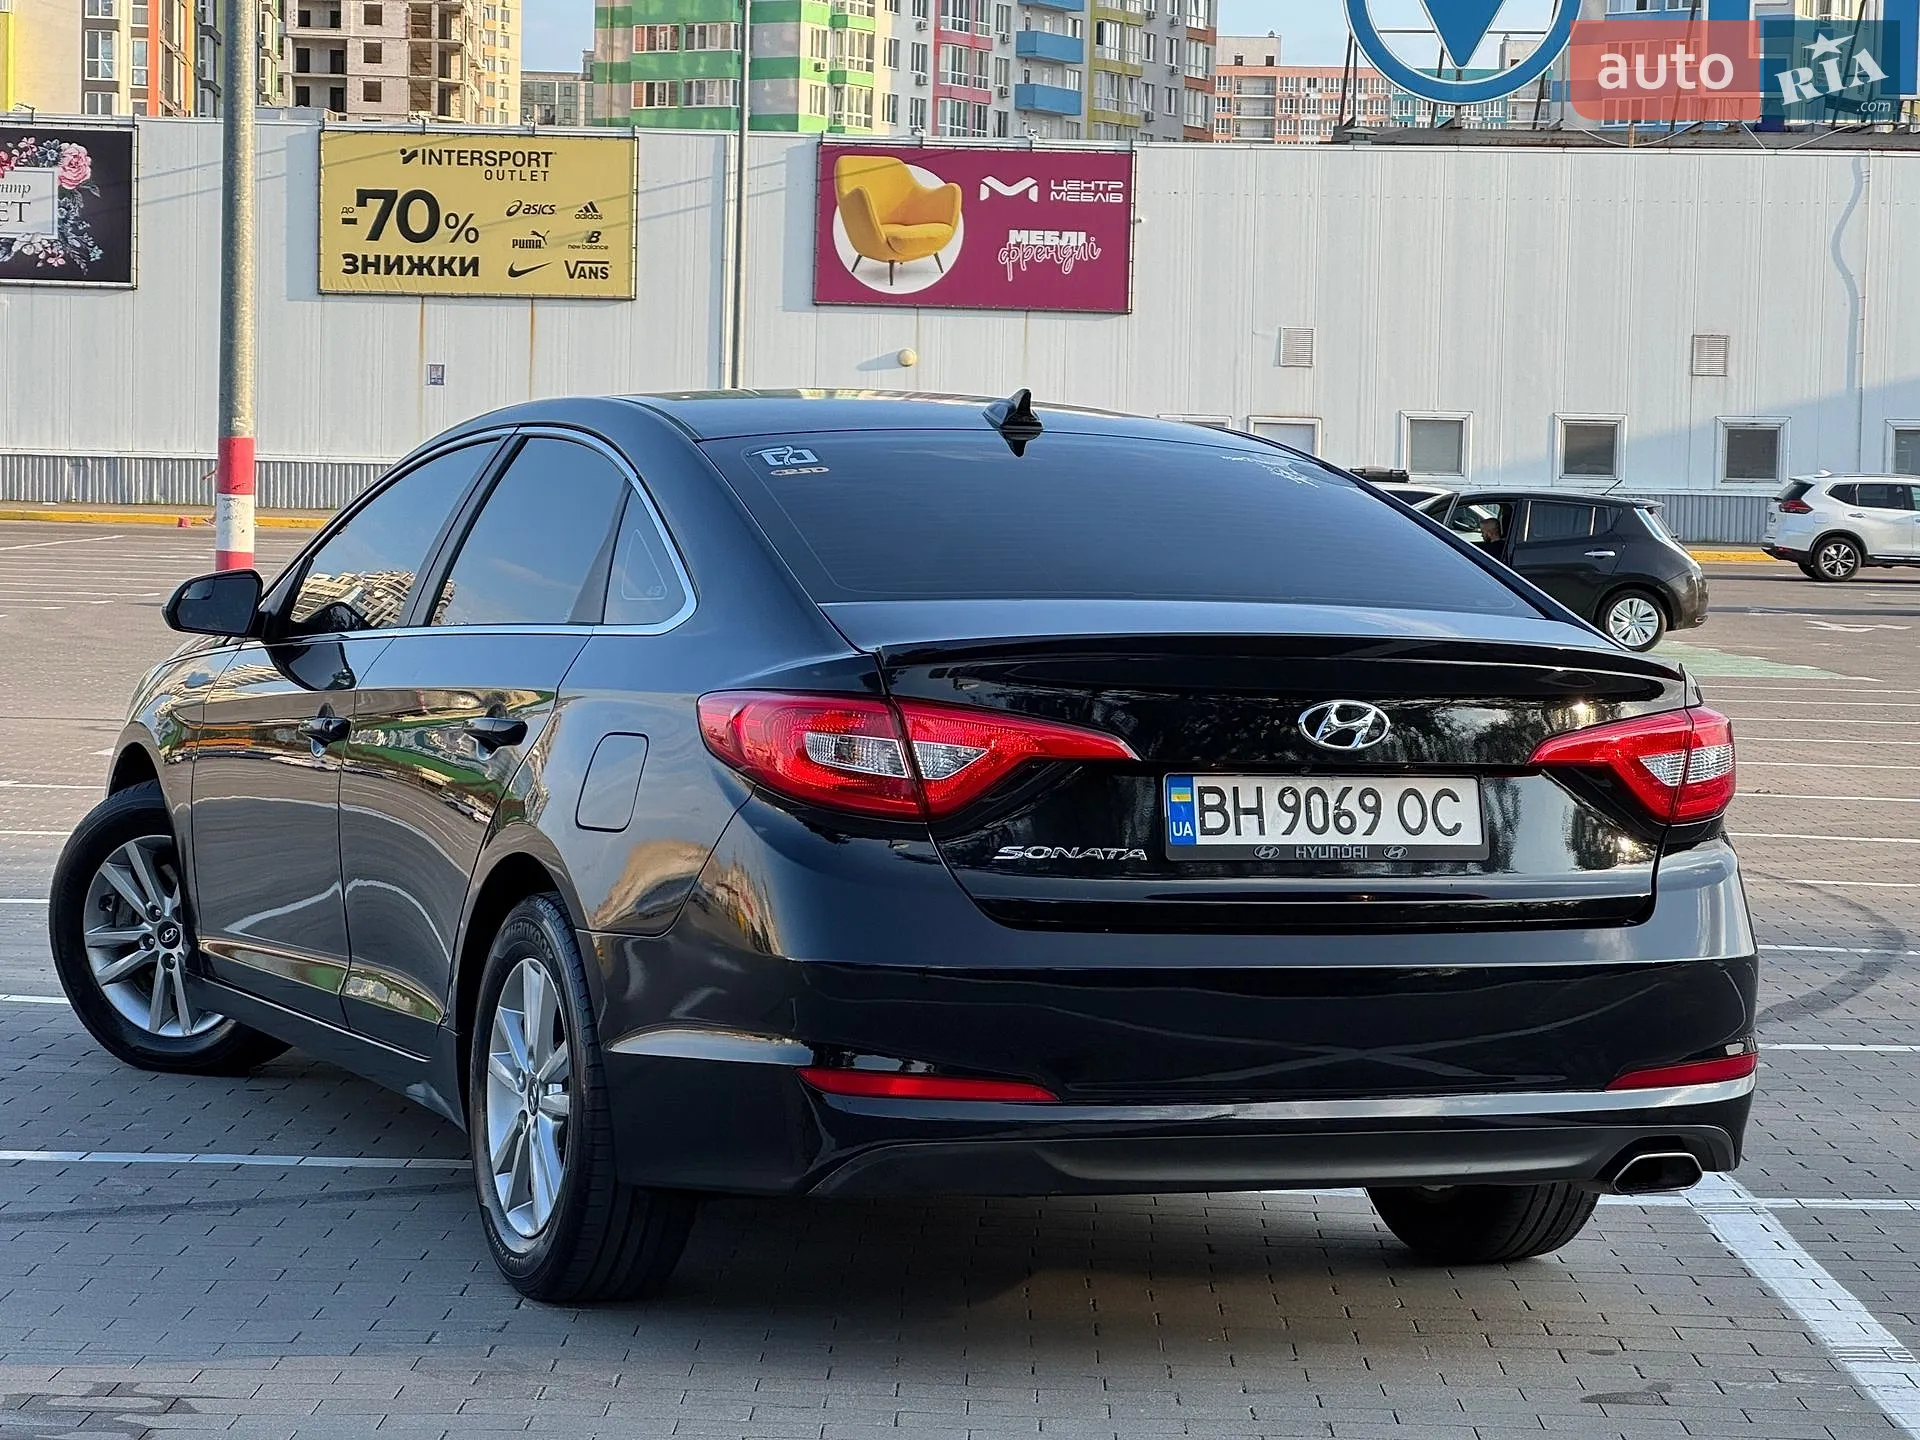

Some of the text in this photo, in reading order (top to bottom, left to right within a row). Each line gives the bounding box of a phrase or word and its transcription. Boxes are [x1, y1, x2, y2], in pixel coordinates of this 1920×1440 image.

[421, 148, 553, 168] INTERSPORT
[484, 169, 550, 182] OUTLET
[1050, 179, 1124, 191] ЦЕНТР
[1050, 191, 1124, 203] МЕБЛІВ
[511, 239, 542, 249] PUMA
[1008, 229, 1087, 246] МЕБЛІ
[341, 252, 480, 277] ЗНИЖКИ
[1197, 785, 1463, 837] BH 9069 OC
[1172, 821, 1194, 837] UA
[992, 845, 1148, 861] SONATA
[1295, 846, 1368, 859] HYUNDAI
